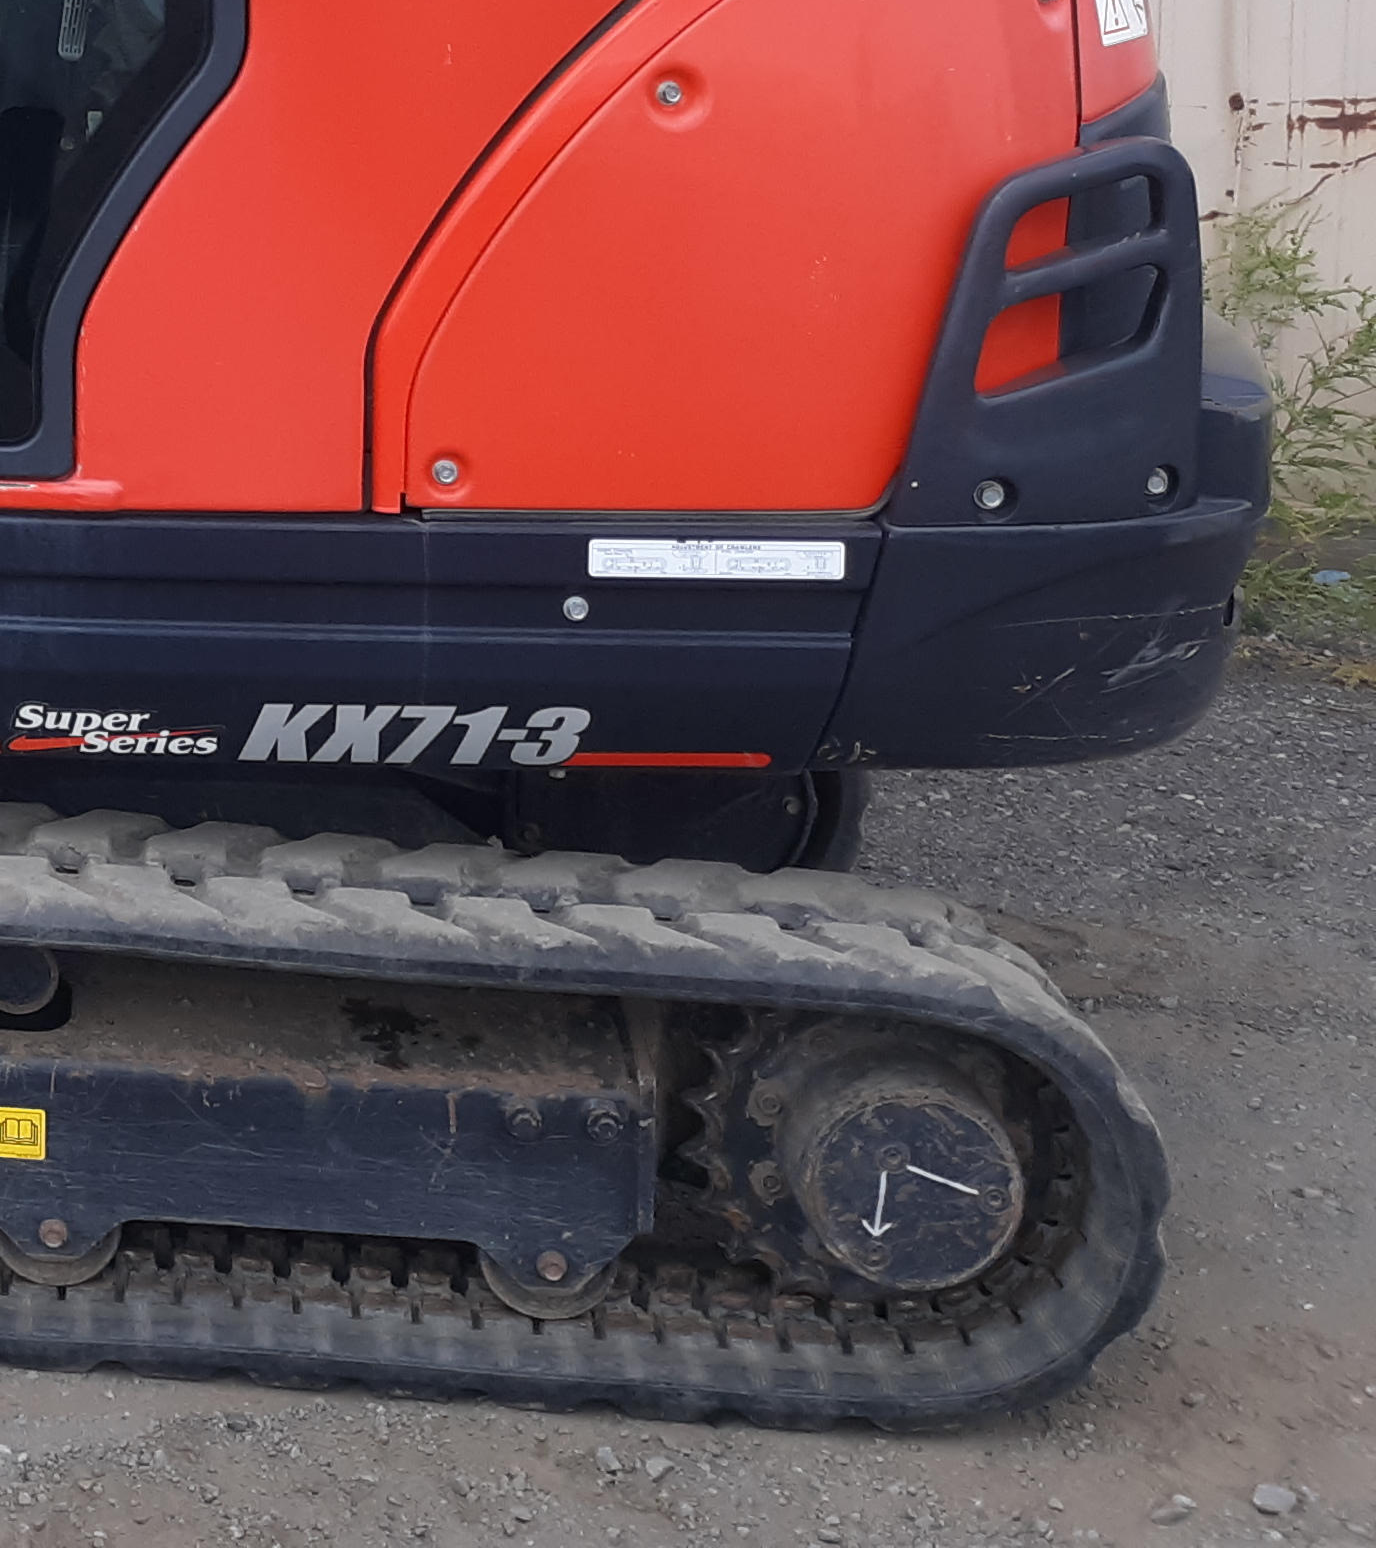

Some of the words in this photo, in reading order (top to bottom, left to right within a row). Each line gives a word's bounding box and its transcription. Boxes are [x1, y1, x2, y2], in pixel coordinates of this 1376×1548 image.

[15, 704, 151, 737] Super
[236, 703, 591, 766] KX71-3
[79, 729, 218, 755] Series
